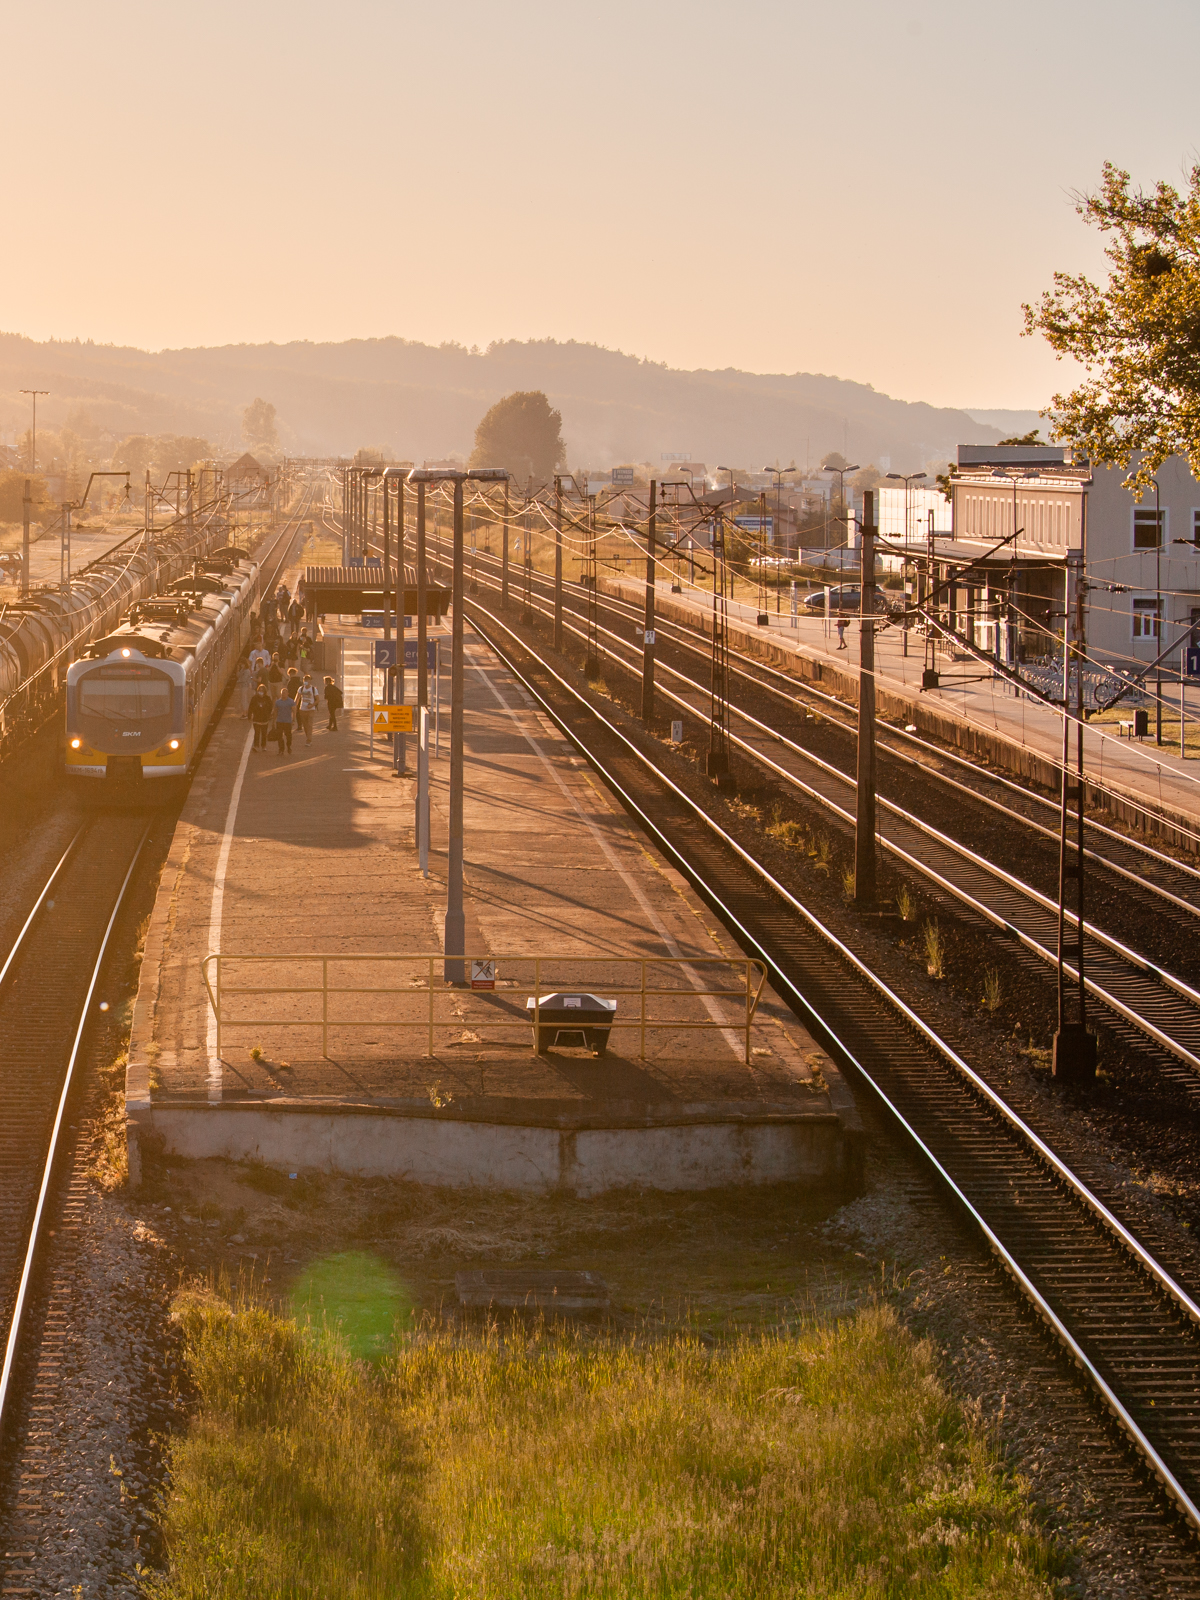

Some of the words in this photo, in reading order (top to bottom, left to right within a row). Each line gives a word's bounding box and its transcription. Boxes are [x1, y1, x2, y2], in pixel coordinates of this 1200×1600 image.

[365, 619, 371, 627] 2
[379, 649, 390, 665] 2
[1190, 655, 1197, 671] 1
